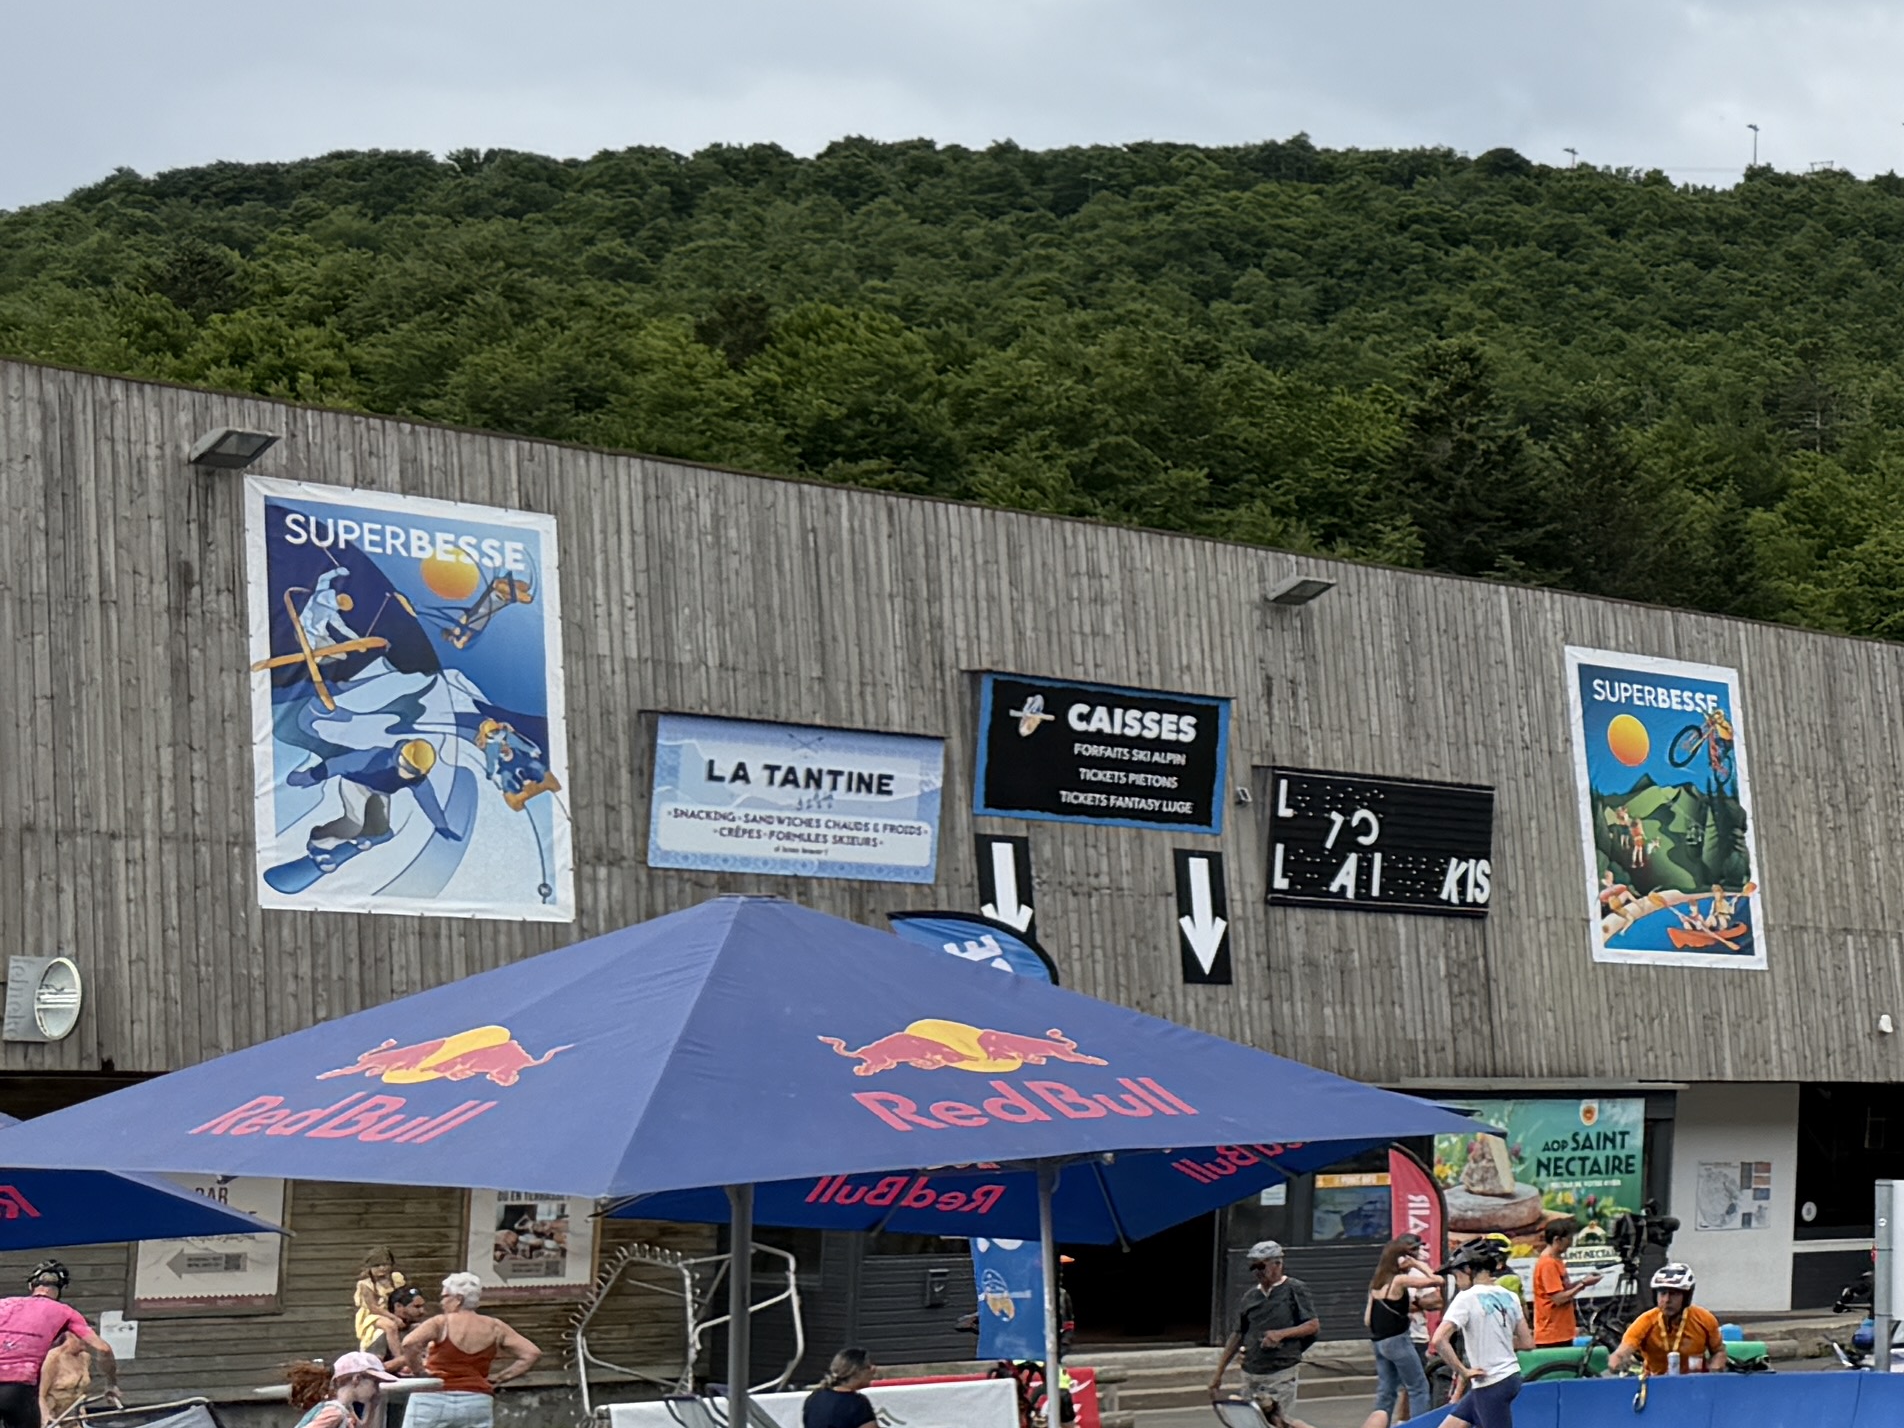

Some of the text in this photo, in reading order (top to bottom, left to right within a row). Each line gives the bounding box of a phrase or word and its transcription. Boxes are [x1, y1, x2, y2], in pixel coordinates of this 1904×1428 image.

[284, 512, 526, 572] SUPERBESSE
[1592, 678, 1718, 714] SUPERBESSE
[1067, 703, 1198, 743] CAISSES
[1073, 742, 1187, 766] FORFAITS SKI ALPIN
[705, 759, 895, 796] LA TANTINE
[1078, 767, 1179, 789] TICKETS PIETONS
[1058, 789, 1194, 815] TICKETS FANTASY LUGE
[823, 818, 870, 833] CHAUDS
[1542, 1131, 1630, 1152] AOP SAINT
[1536, 1154, 1636, 1178] NECTAIRE
